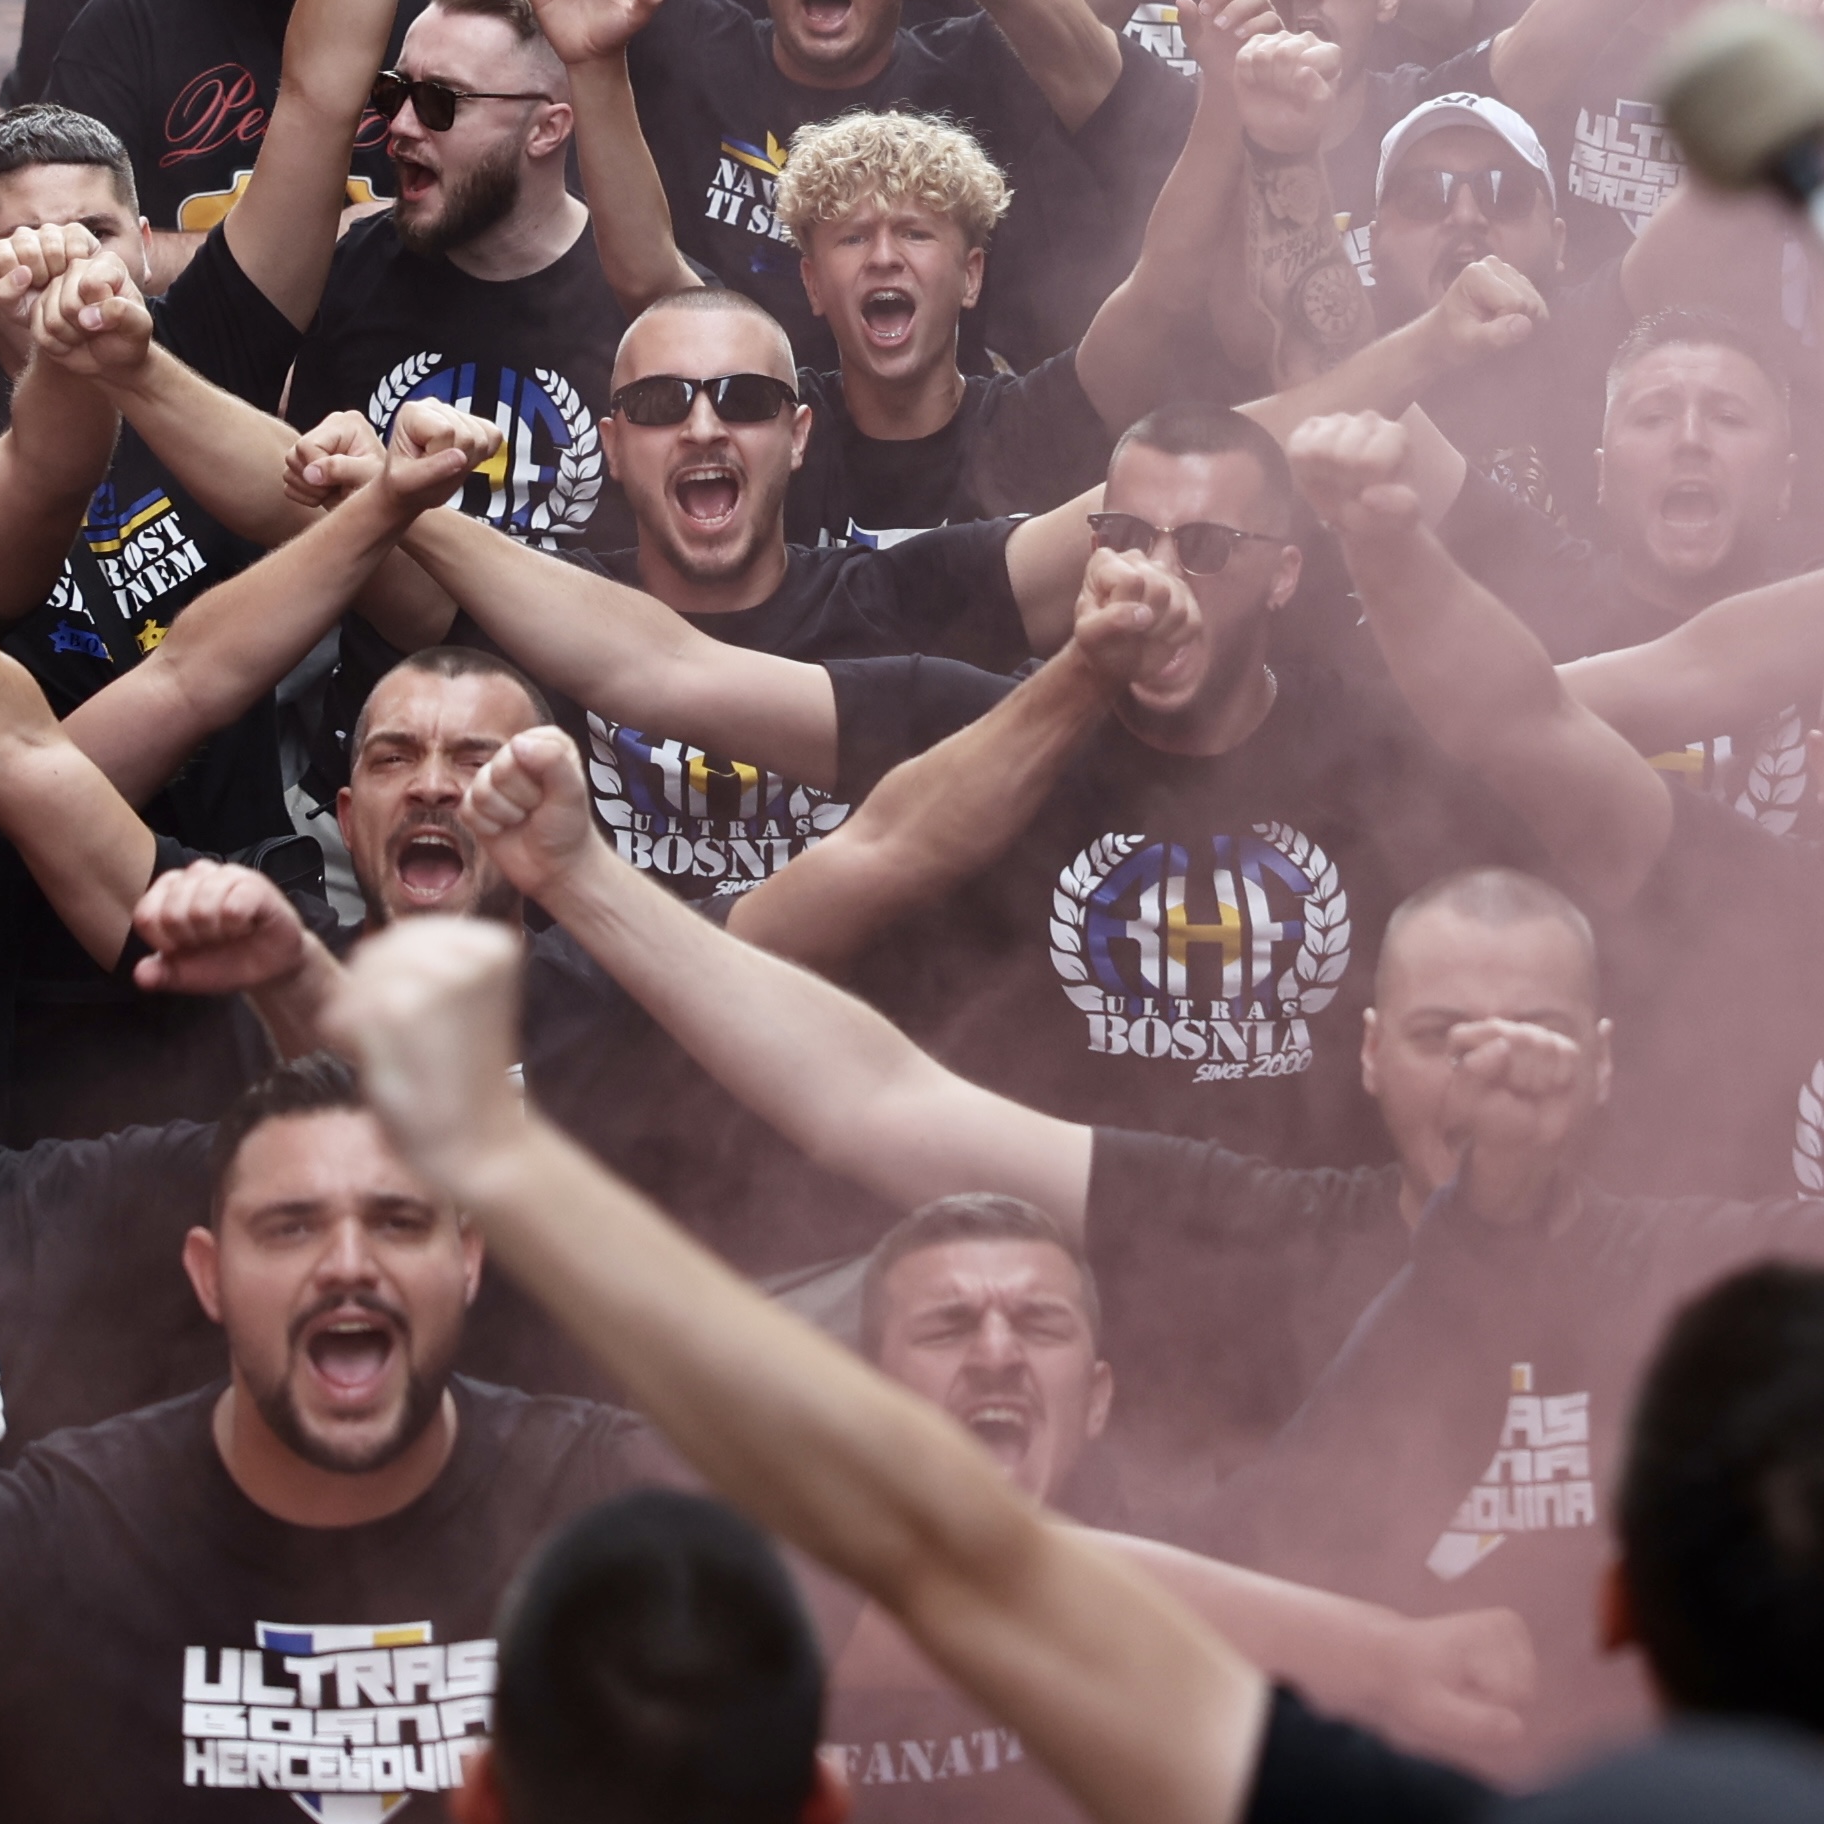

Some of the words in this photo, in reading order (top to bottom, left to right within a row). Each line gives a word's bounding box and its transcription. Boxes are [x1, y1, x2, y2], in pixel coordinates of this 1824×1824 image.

[712, 158, 756, 198] NA
[705, 187, 744, 226] TI
[633, 816, 816, 838] ULTRAS
[1104, 996, 1298, 1023] ULTRAS
[1087, 1014, 1311, 1061] BOSNIA
[1192, 1058, 1254, 1083] SINCE
[1253, 1049, 1314, 1078] 2000
[183, 1639, 500, 1711] ULTRAS
[183, 1698, 496, 1744] BOSNA
